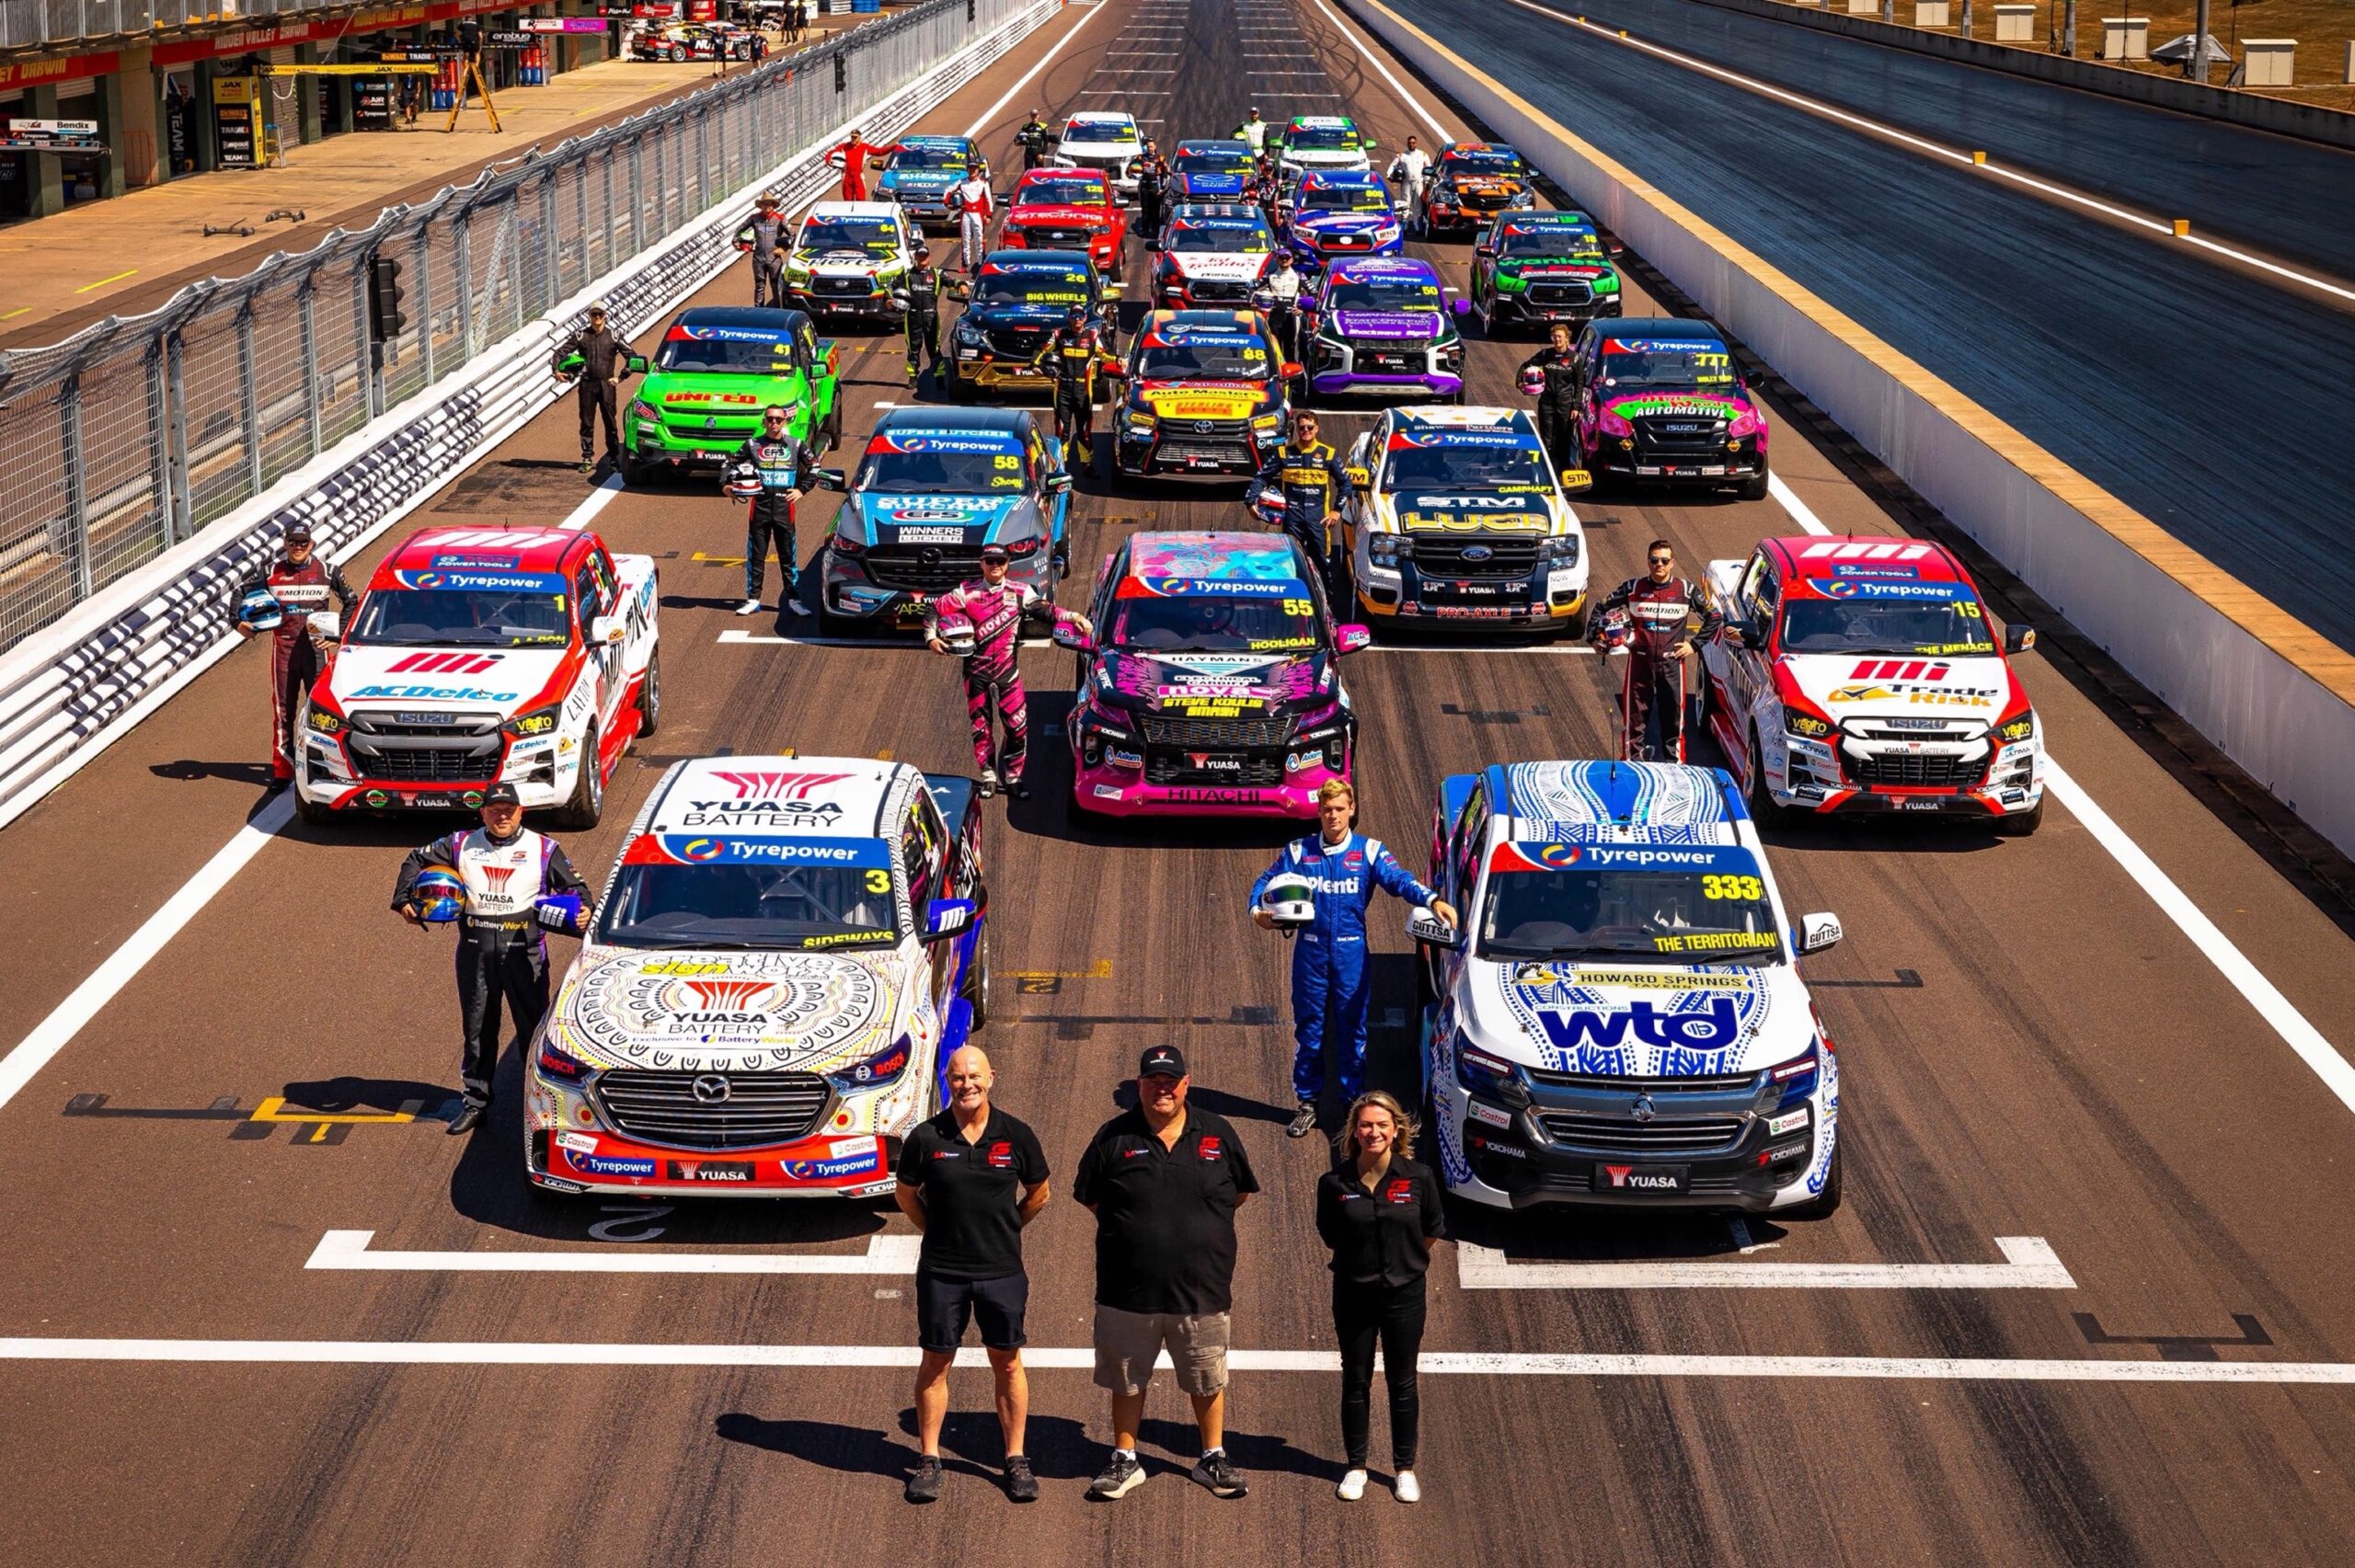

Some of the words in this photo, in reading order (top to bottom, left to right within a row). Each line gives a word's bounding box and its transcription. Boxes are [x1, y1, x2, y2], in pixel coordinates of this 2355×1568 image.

[20, 58, 67, 80] DARWIN
[56, 121, 89, 130] Bendix
[1065, 273, 1086, 283] 26
[1026, 292, 1044, 302] BIG
[1046, 293, 1087, 303] WHEELS
[1421, 287, 1438, 295] 50
[718, 330, 778, 340] Tyrepower
[1190, 337, 1250, 345] Tyrepower
[1653, 341, 1712, 350] Tyrepower
[1244, 349, 1266, 361] 88
[1695, 354, 1729, 367] 777
[1635, 406, 1727, 418] AUTOMOTIVE
[1445, 434, 1519, 445] Tyrepower
[930, 441, 1005, 452] Tyrepower
[994, 456, 1019, 470] 58
[1528, 451, 1540, 463] 7
[991, 476, 1024, 488] Shoey
[1417, 497, 1526, 507] STM
[899, 526, 964, 535] WINNERS
[1033, 557, 1048, 568] BECK
[450, 575, 543, 589] Tyrepower
[1195, 580, 1286, 593] Tyrepower
[1862, 583, 1953, 597] Tyrepower
[554, 595, 566, 612] 1
[1283, 600, 1314, 616] 55
[1952, 601, 1981, 618] 15
[978, 610, 1011, 638] nova
[1251, 637, 1315, 650] HOOLIGAN
[1943, 643, 1993, 654] MENACE
[350, 685, 518, 702] ACDelco
[1168, 686, 1251, 695] nova
[1888, 684, 1998, 696] Trade
[1164, 698, 1211, 707] STEVE
[1909, 693, 1992, 706] Risk
[1187, 706, 1240, 717] SMASH
[397, 713, 453, 724] ISUZU
[1891, 718, 1943, 728] ISUZU
[311, 736, 338, 748] ACDelco
[512, 738, 548, 751] ACDelco
[1116, 750, 1141, 761] Axiom
[1302, 750, 1323, 761] Axiom
[1207, 761, 1240, 770] YUASA
[1168, 789, 1260, 803] HITACHI
[690, 800, 844, 814] YUASA
[1905, 802, 1939, 810] YUASA
[682, 813, 843, 827] BATTERY
[729, 841, 858, 861] Tyrepower
[1587, 846, 1716, 864] Tyrepower
[865, 869, 890, 894] 3
[1308, 876, 1360, 894] Plenti
[1703, 876, 1761, 901] 333
[478, 893, 514, 903] YUASA
[477, 902, 514, 911] BATTERY
[475, 920, 528, 930] BatteryWorld
[1412, 920, 1451, 937] GUTTSA
[1809, 925, 1841, 945] GUTTSA
[1655, 936, 1683, 953] THE
[1685, 932, 1777, 950] TERRITORIAN
[1580, 974, 1657, 984] HOWARD
[1664, 976, 1742, 988] SPRINGS
[673, 1013, 768, 1024] YUASA
[1538, 1000, 1738, 1050] wtd
[668, 1024, 767, 1035] BATTERY
[541, 1054, 576, 1075] BOSCH
[875, 1050, 904, 1077] BOSCH
[1479, 1109, 1509, 1127] Castrol
[1781, 1114, 1807, 1129] Castrol
[567, 1135, 595, 1150] Castrol
[844, 1140, 876, 1153] Castrol
[1486, 1140, 1527, 1160] YOKOHAMA
[1770, 1144, 1807, 1162] YOKOHAMA
[590, 1157, 654, 1174] Tyrepower
[816, 1156, 876, 1176] Tyrepower
[700, 1170, 748, 1182] YUASA
[1628, 1175, 1678, 1189] YUASA
